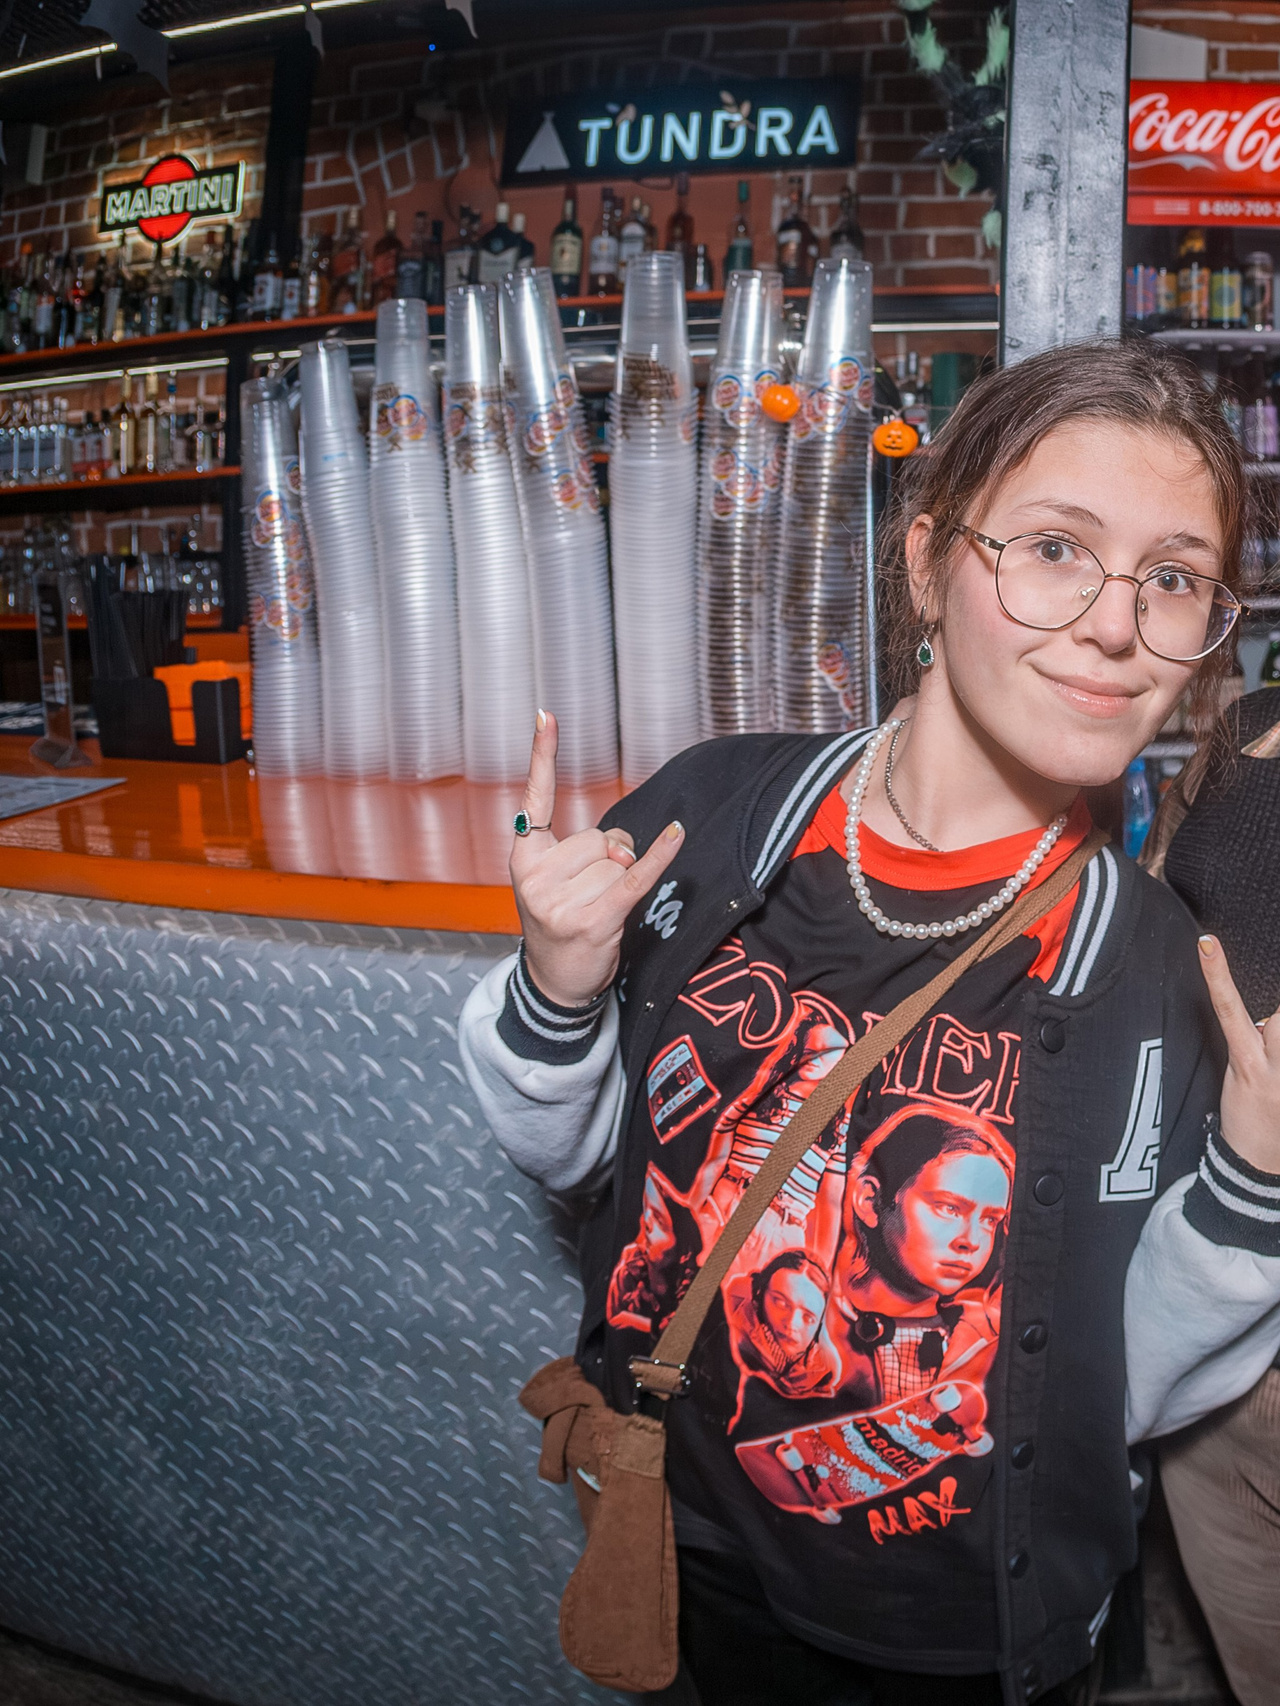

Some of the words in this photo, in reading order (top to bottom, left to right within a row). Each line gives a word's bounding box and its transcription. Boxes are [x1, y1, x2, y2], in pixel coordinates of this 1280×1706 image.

[578, 104, 840, 168] TUNDRA
[105, 172, 236, 226] MARTINI
[867, 1475, 972, 1546] MAX
